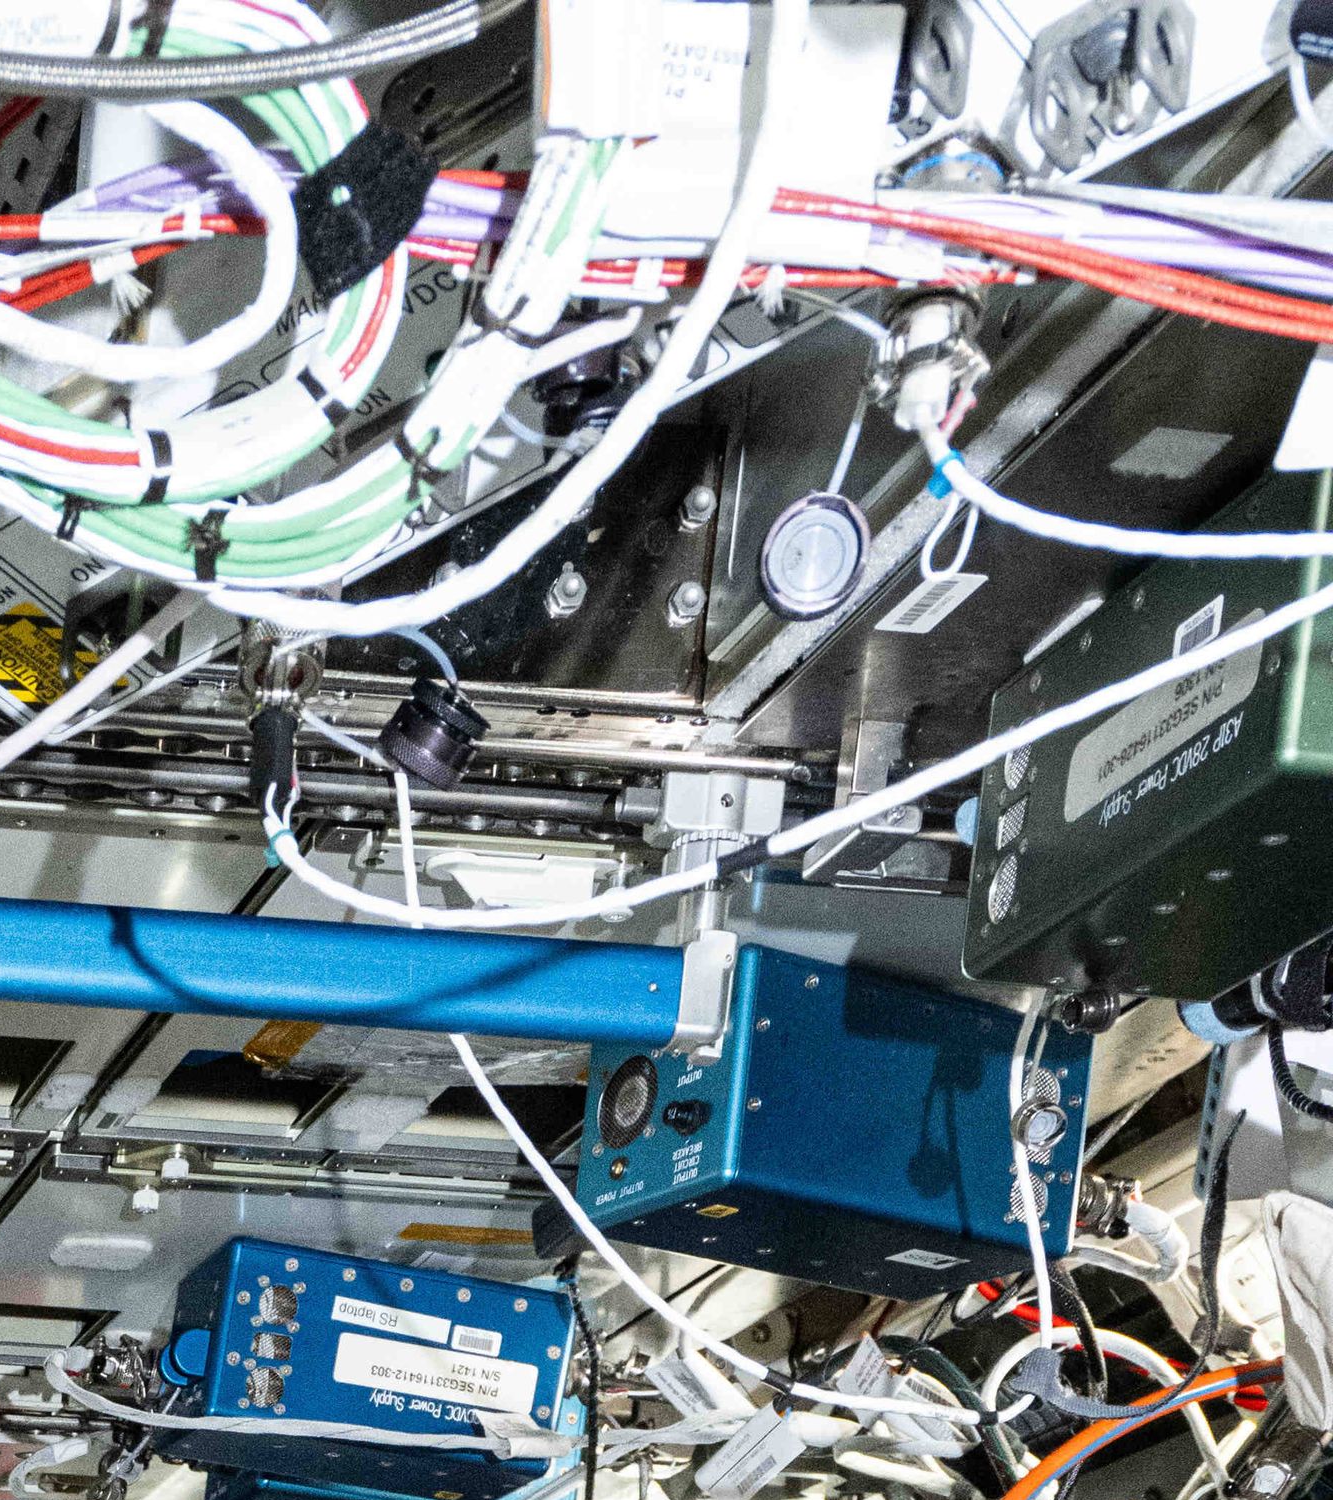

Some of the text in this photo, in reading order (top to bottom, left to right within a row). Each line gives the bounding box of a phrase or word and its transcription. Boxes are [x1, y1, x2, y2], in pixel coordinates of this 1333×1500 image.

[1133, 764, 1163, 800] Power
[1098, 787, 1132, 824] Supply
[672, 1140, 702, 1160] BREAKER
[673, 1154, 700, 1171] CIRCUIT
[672, 1167, 698, 1184] OUTPUT
[593, 1180, 645, 1206] OUTPUT POWER
[337, 1301, 398, 1329] RS laptop
[370, 1364, 499, 1397] P/N SEG33116412-303
[450, 1362, 501, 1381] S/N 1421
[369, 1388, 405, 1410] Supply
[408, 1398, 442, 1416] Power
